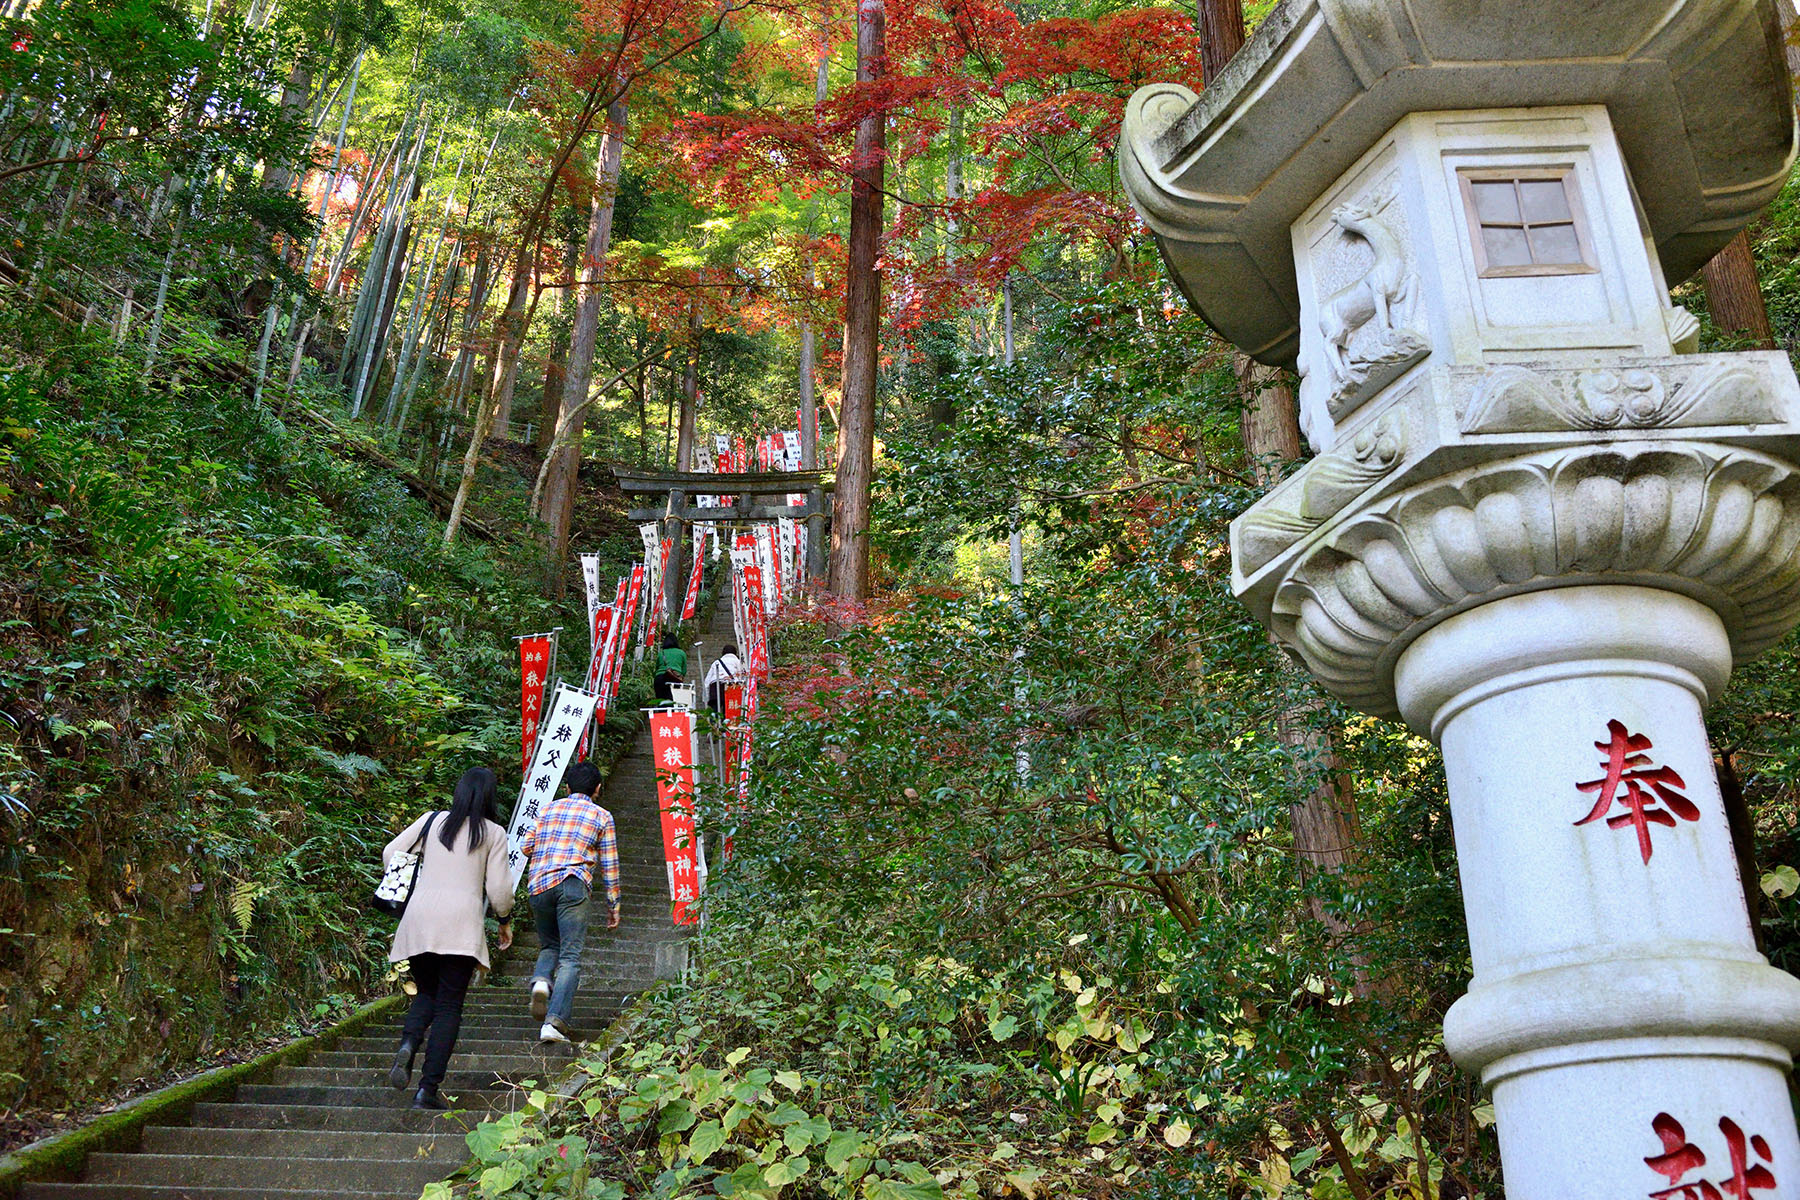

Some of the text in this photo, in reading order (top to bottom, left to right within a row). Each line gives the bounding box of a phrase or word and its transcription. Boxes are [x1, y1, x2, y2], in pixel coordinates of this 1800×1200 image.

[525, 652, 542, 663] 奉納
[525, 670, 539, 772] 秩父御嶽
[659, 726, 683, 739] 奉納
